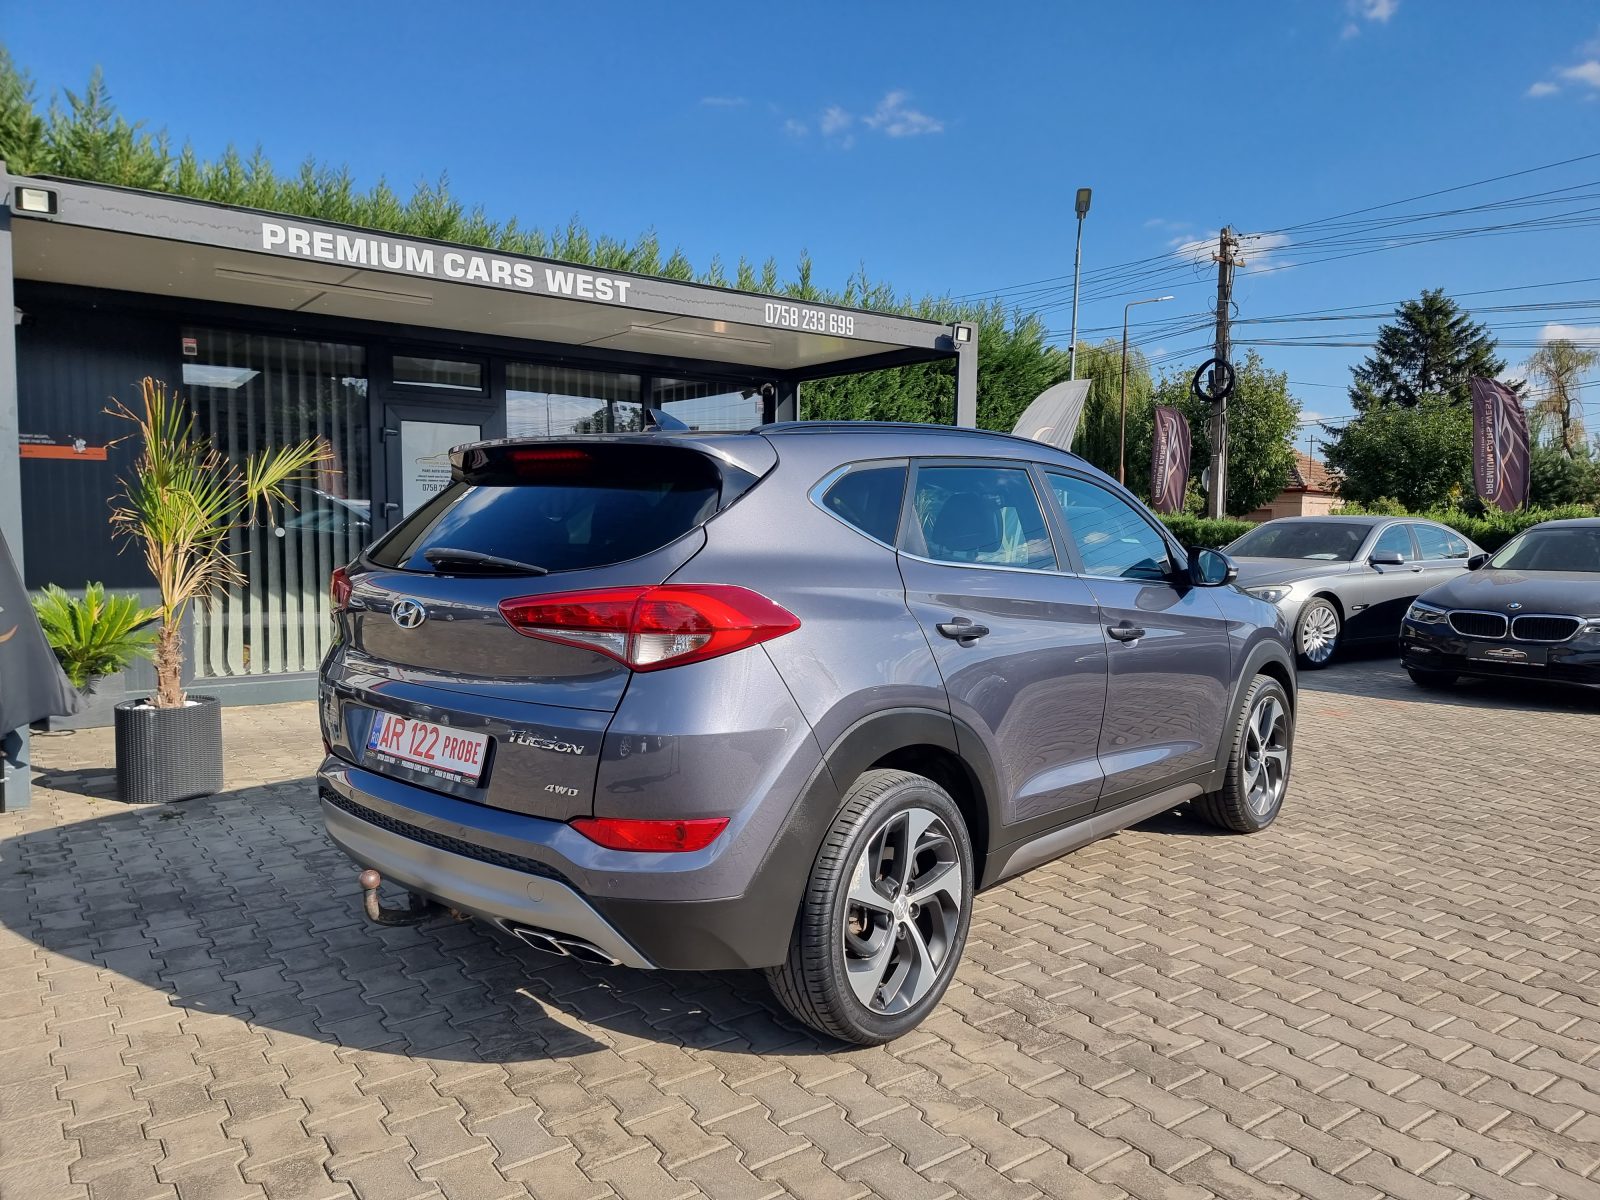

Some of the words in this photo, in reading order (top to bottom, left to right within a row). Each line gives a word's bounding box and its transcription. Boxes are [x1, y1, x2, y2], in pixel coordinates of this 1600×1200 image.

[262, 222, 434, 274] PREMIUM
[443, 252, 534, 288] CARS
[545, 268, 631, 303] WEST
[765, 303, 799, 327] 0758
[802, 309, 826, 331] 233
[829, 314, 854, 336] 699
[422, 483, 438, 491] 0758
[380, 716, 406, 751] AR
[408, 722, 440, 760] 122
[442, 735, 482, 765] PROBE
[544, 784, 579, 797] 4WD
